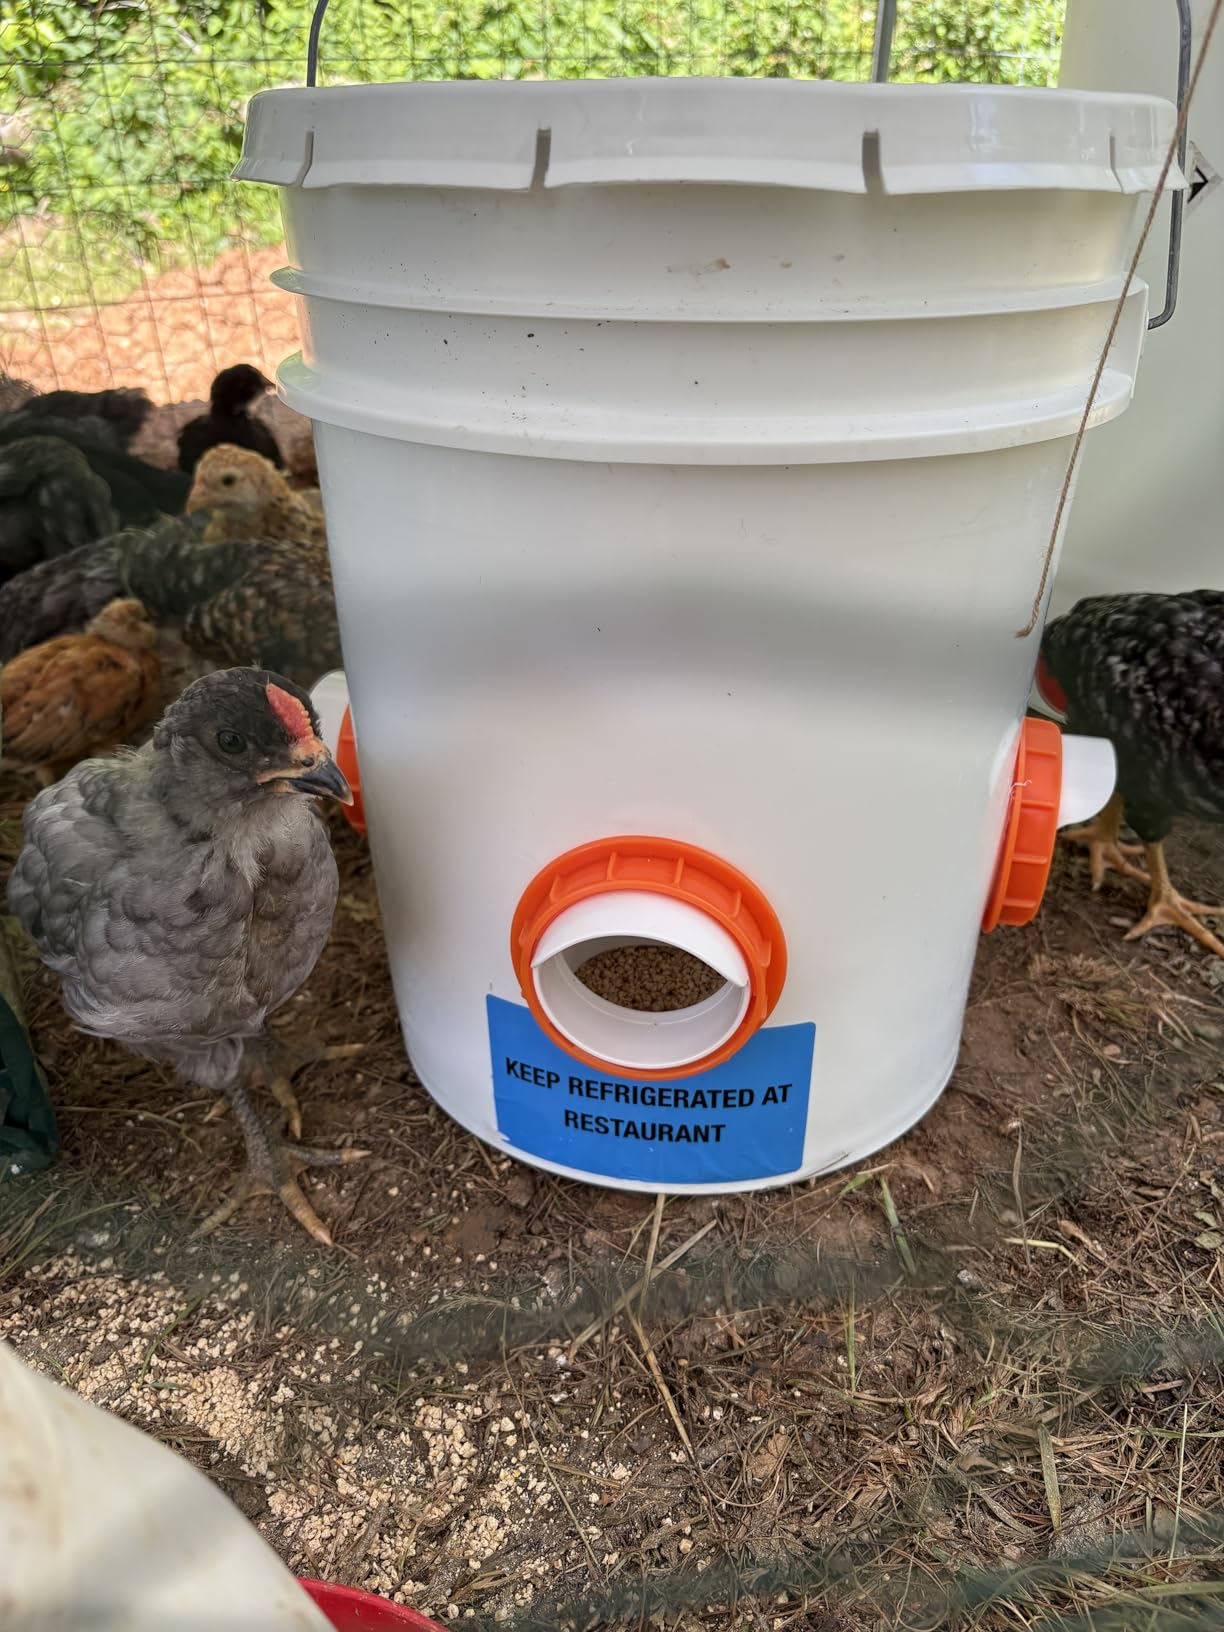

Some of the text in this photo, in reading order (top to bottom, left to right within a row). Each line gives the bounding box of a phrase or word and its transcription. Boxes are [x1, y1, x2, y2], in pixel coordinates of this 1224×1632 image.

[505, 1057, 793, 1109] KEEP REFRIGERATED AT
[564, 1110, 726, 1143] RESTAURANT
